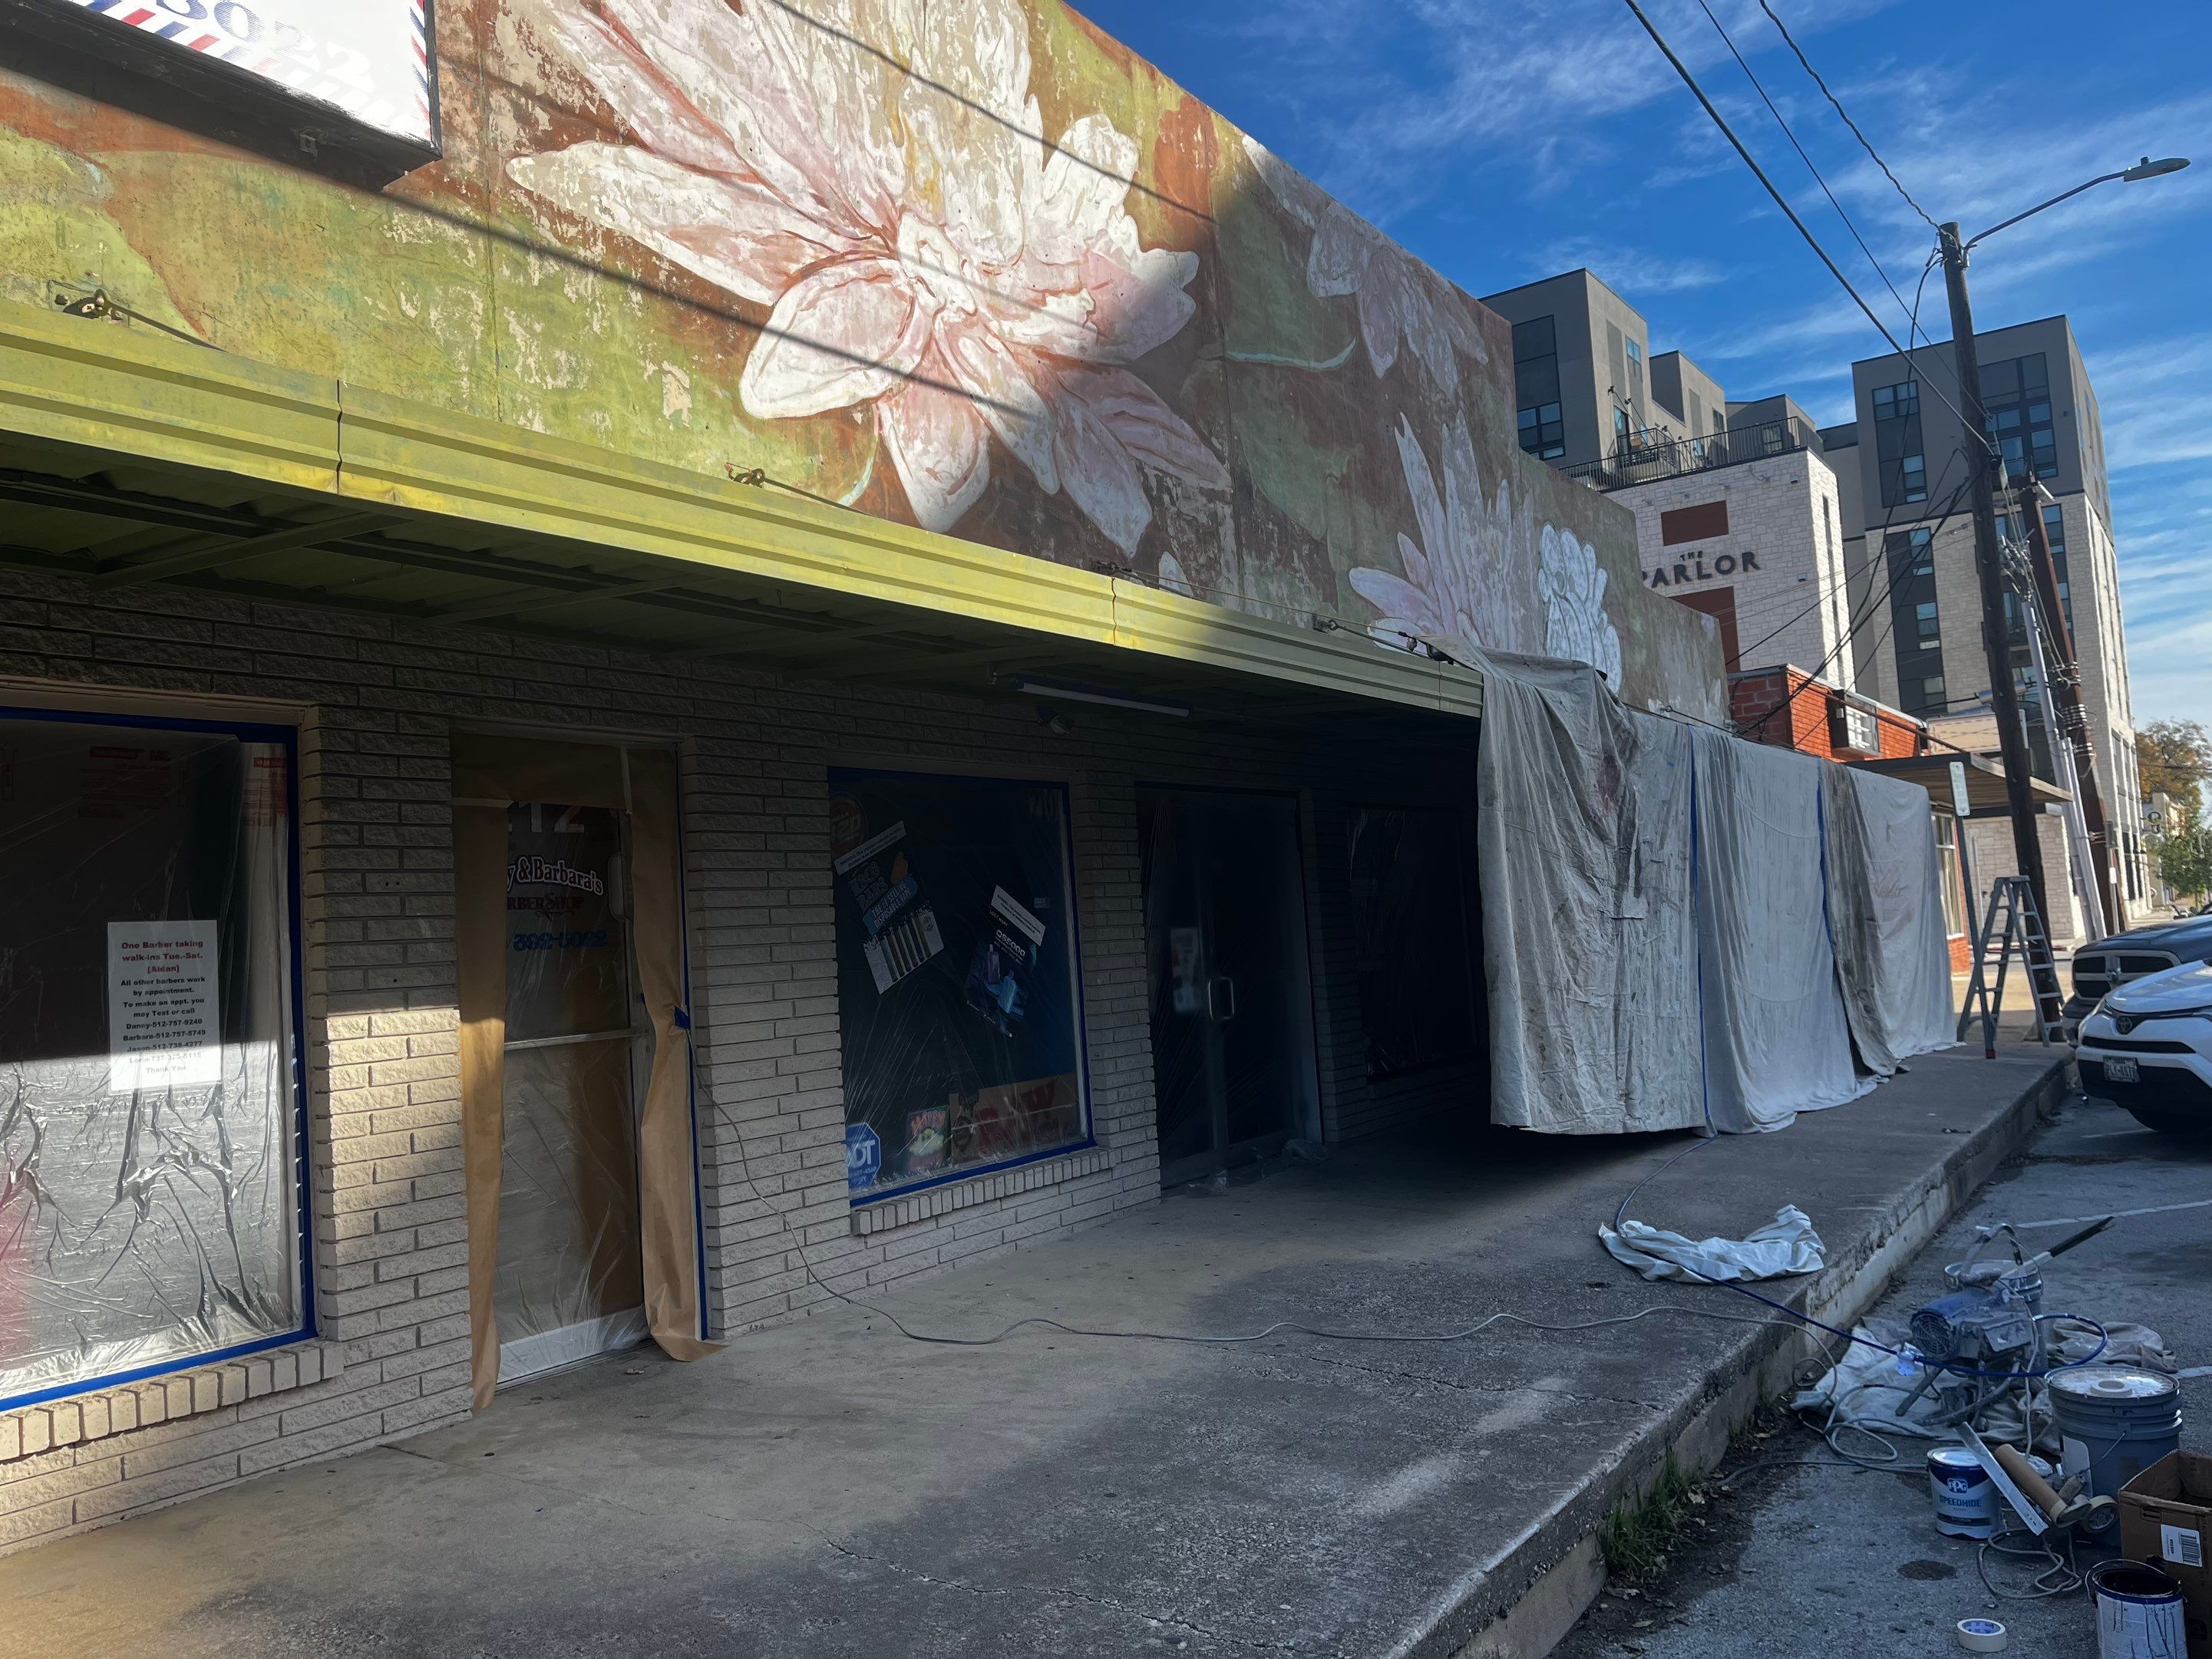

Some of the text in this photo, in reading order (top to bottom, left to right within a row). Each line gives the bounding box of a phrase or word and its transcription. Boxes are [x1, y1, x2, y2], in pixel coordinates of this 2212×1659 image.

[1679, 550, 1704, 561] THE
[517, 856, 532, 884] &
[531, 856, 605, 896] Barbara's
[144, 987, 195, 996] appointment.
[1950, 1479, 1967, 1493] PPG
[1939, 1494, 1982, 1507] SPEEDHIDE
